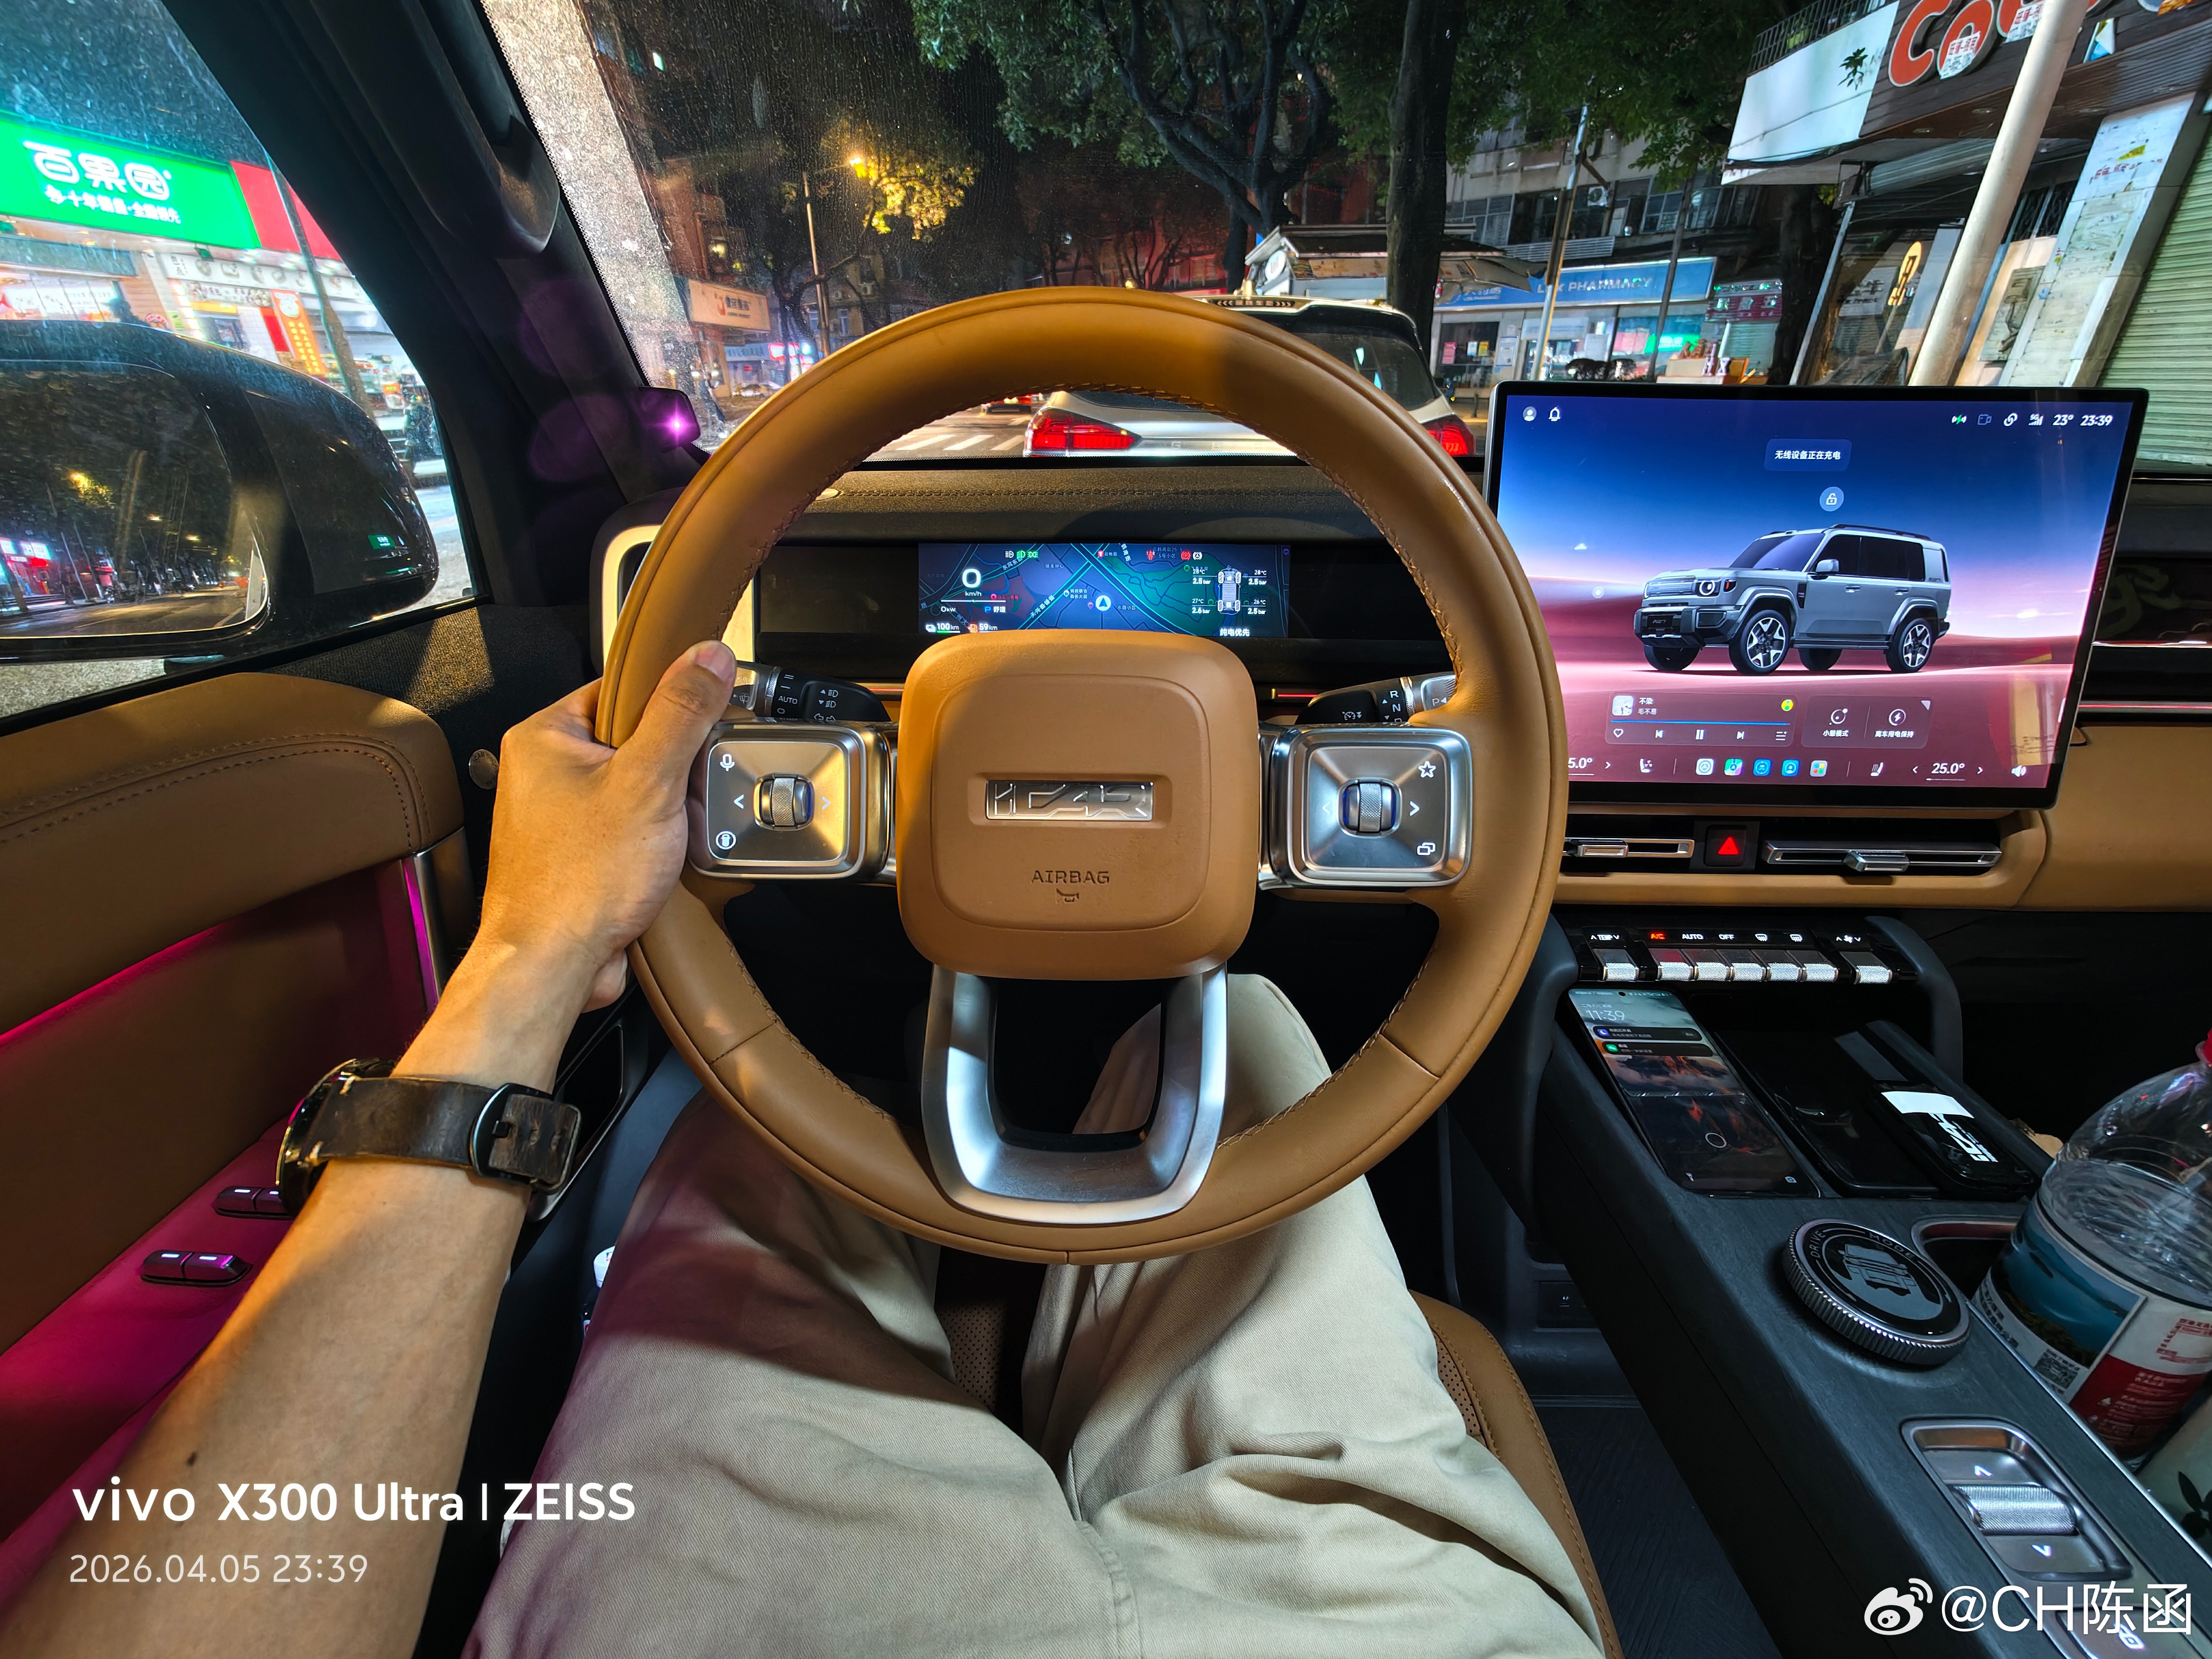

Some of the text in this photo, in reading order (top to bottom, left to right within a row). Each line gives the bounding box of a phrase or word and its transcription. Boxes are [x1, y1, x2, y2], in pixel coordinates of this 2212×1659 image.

[23, 140, 171, 200] 百果园
[1568, 277, 1654, 291] PHARMACY
[2053, 414, 2113, 426] 23° 23:39
[1775, 450, 1840, 460] 无线设备正在充电
[962, 568, 981, 588] 0
[1219, 628, 1250, 637] 纯电优先
[1390, 690, 1399, 698] R
[778, 696, 798, 705] AUTO
[1433, 698, 1440, 706] P
[1392, 703, 1401, 712] N
[1874, 730, 1914, 738] 离车用电保持
[1931, 762, 1965, 774] 25.0°
[1031, 870, 1110, 884] AIRBAG
[1586, 1010, 1626, 1021] 11:39
[1809, 1230, 1916, 1259] DRIVE MODE
